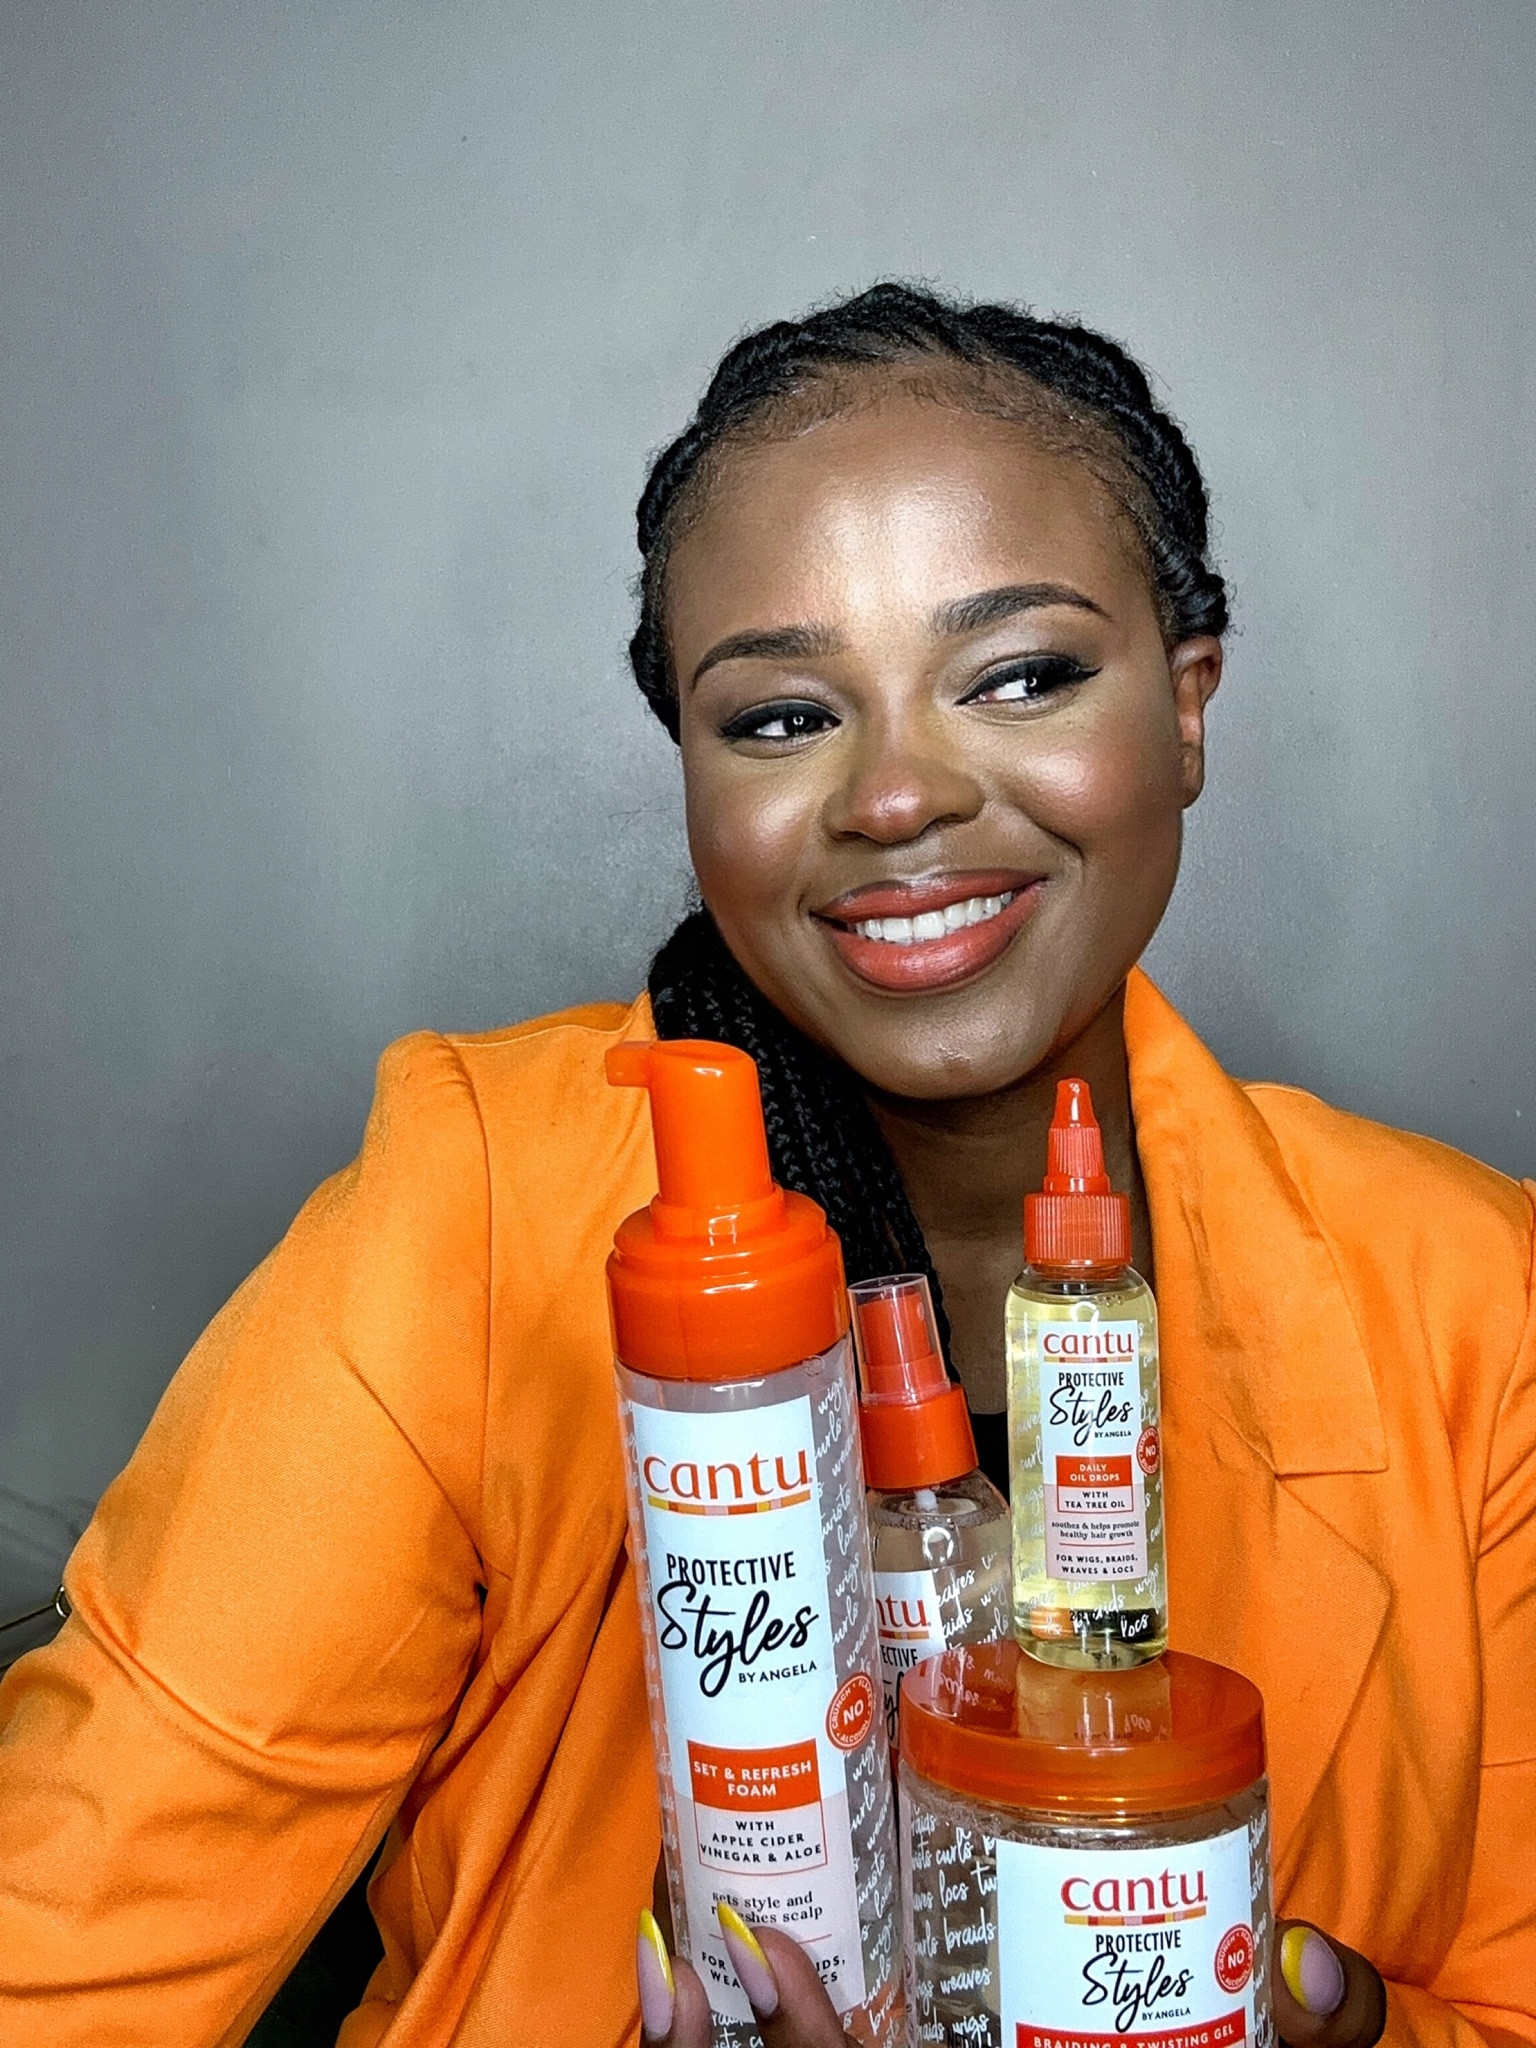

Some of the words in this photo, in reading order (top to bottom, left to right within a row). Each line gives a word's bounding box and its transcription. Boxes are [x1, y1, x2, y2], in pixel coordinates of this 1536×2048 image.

[1043, 1329, 1134, 1354] cantu
[1058, 1372, 1125, 1388] PROTECTIVE
[1049, 1385, 1134, 1447] Styles
[1094, 1431, 1104, 1439] BY
[1105, 1430, 1132, 1438] ANGELA
[1145, 1444, 1156, 1457] NO
[642, 1449, 812, 1500] cantu
[1069, 1473, 1087, 1482] OIL
[1089, 1473, 1120, 1482] DROPS
[1079, 1463, 1107, 1473] DAILY
[1065, 1500, 1082, 1508] TEA
[1086, 1501, 1107, 1509] TREE
[1110, 1500, 1125, 1508] OIL
[1051, 1521, 1080, 1529] soothes
[1090, 1522, 1111, 1531] helps
[1112, 1520, 1140, 1531] promote
[1060, 1530, 1088, 1541] healthy
[1090, 1531, 1107, 1539] hair
[1109, 1530, 1133, 1540] growth
[666, 1551, 796, 1586] PROTECTIVE
[1056, 1554, 1073, 1562] FOR
[1076, 1555, 1104, 1564] WIGS,
[1105, 1554, 1138, 1563] BRAIDS,
[1061, 1566, 1098, 1574] WEAVES
[1112, 1565, 1134, 1574] LOCS
[657, 1580, 819, 1698] Styles
[881, 1648, 918, 1667] ECTIVE
[738, 1671, 757, 1684] BY
[759, 1660, 818, 1683] ANGELA
[831, 1686, 852, 1730] CRUNCH
[843, 1698, 864, 1726] NO
[694, 1760, 718, 1778] SET
[724, 1766, 735, 1780] &
[741, 1760, 813, 1781] REFRESH
[727, 1782, 777, 1797] FOAM
[735, 1820, 775, 1832] WITH
[711, 1832, 754, 1847] APPLE
[760, 1833, 805, 1847] CIDER
[699, 1844, 763, 1863] VINEGAR
[768, 1852, 778, 1863] &
[785, 1844, 822, 1861] ALOE
[939, 1869, 970, 1909] locs
[1060, 1867, 1205, 1912] cantu
[744, 1896, 781, 1913] style
[786, 1890, 814, 1907] and
[782, 1905, 823, 1922] scalp
[943, 1906, 997, 1955] braids
[1095, 1929, 1182, 1953] PROTECTIVE
[701, 1951, 726, 1971] FOR
[1227, 1949, 1245, 1969] NO
[940, 1967, 993, 1996] weaves
[1081, 1952, 1195, 2033] Styles
[1141, 2011, 1153, 2021] BY
[1155, 2006, 1191, 2019] ANGELA
[1213, 2023, 1234, 2040] GEL
